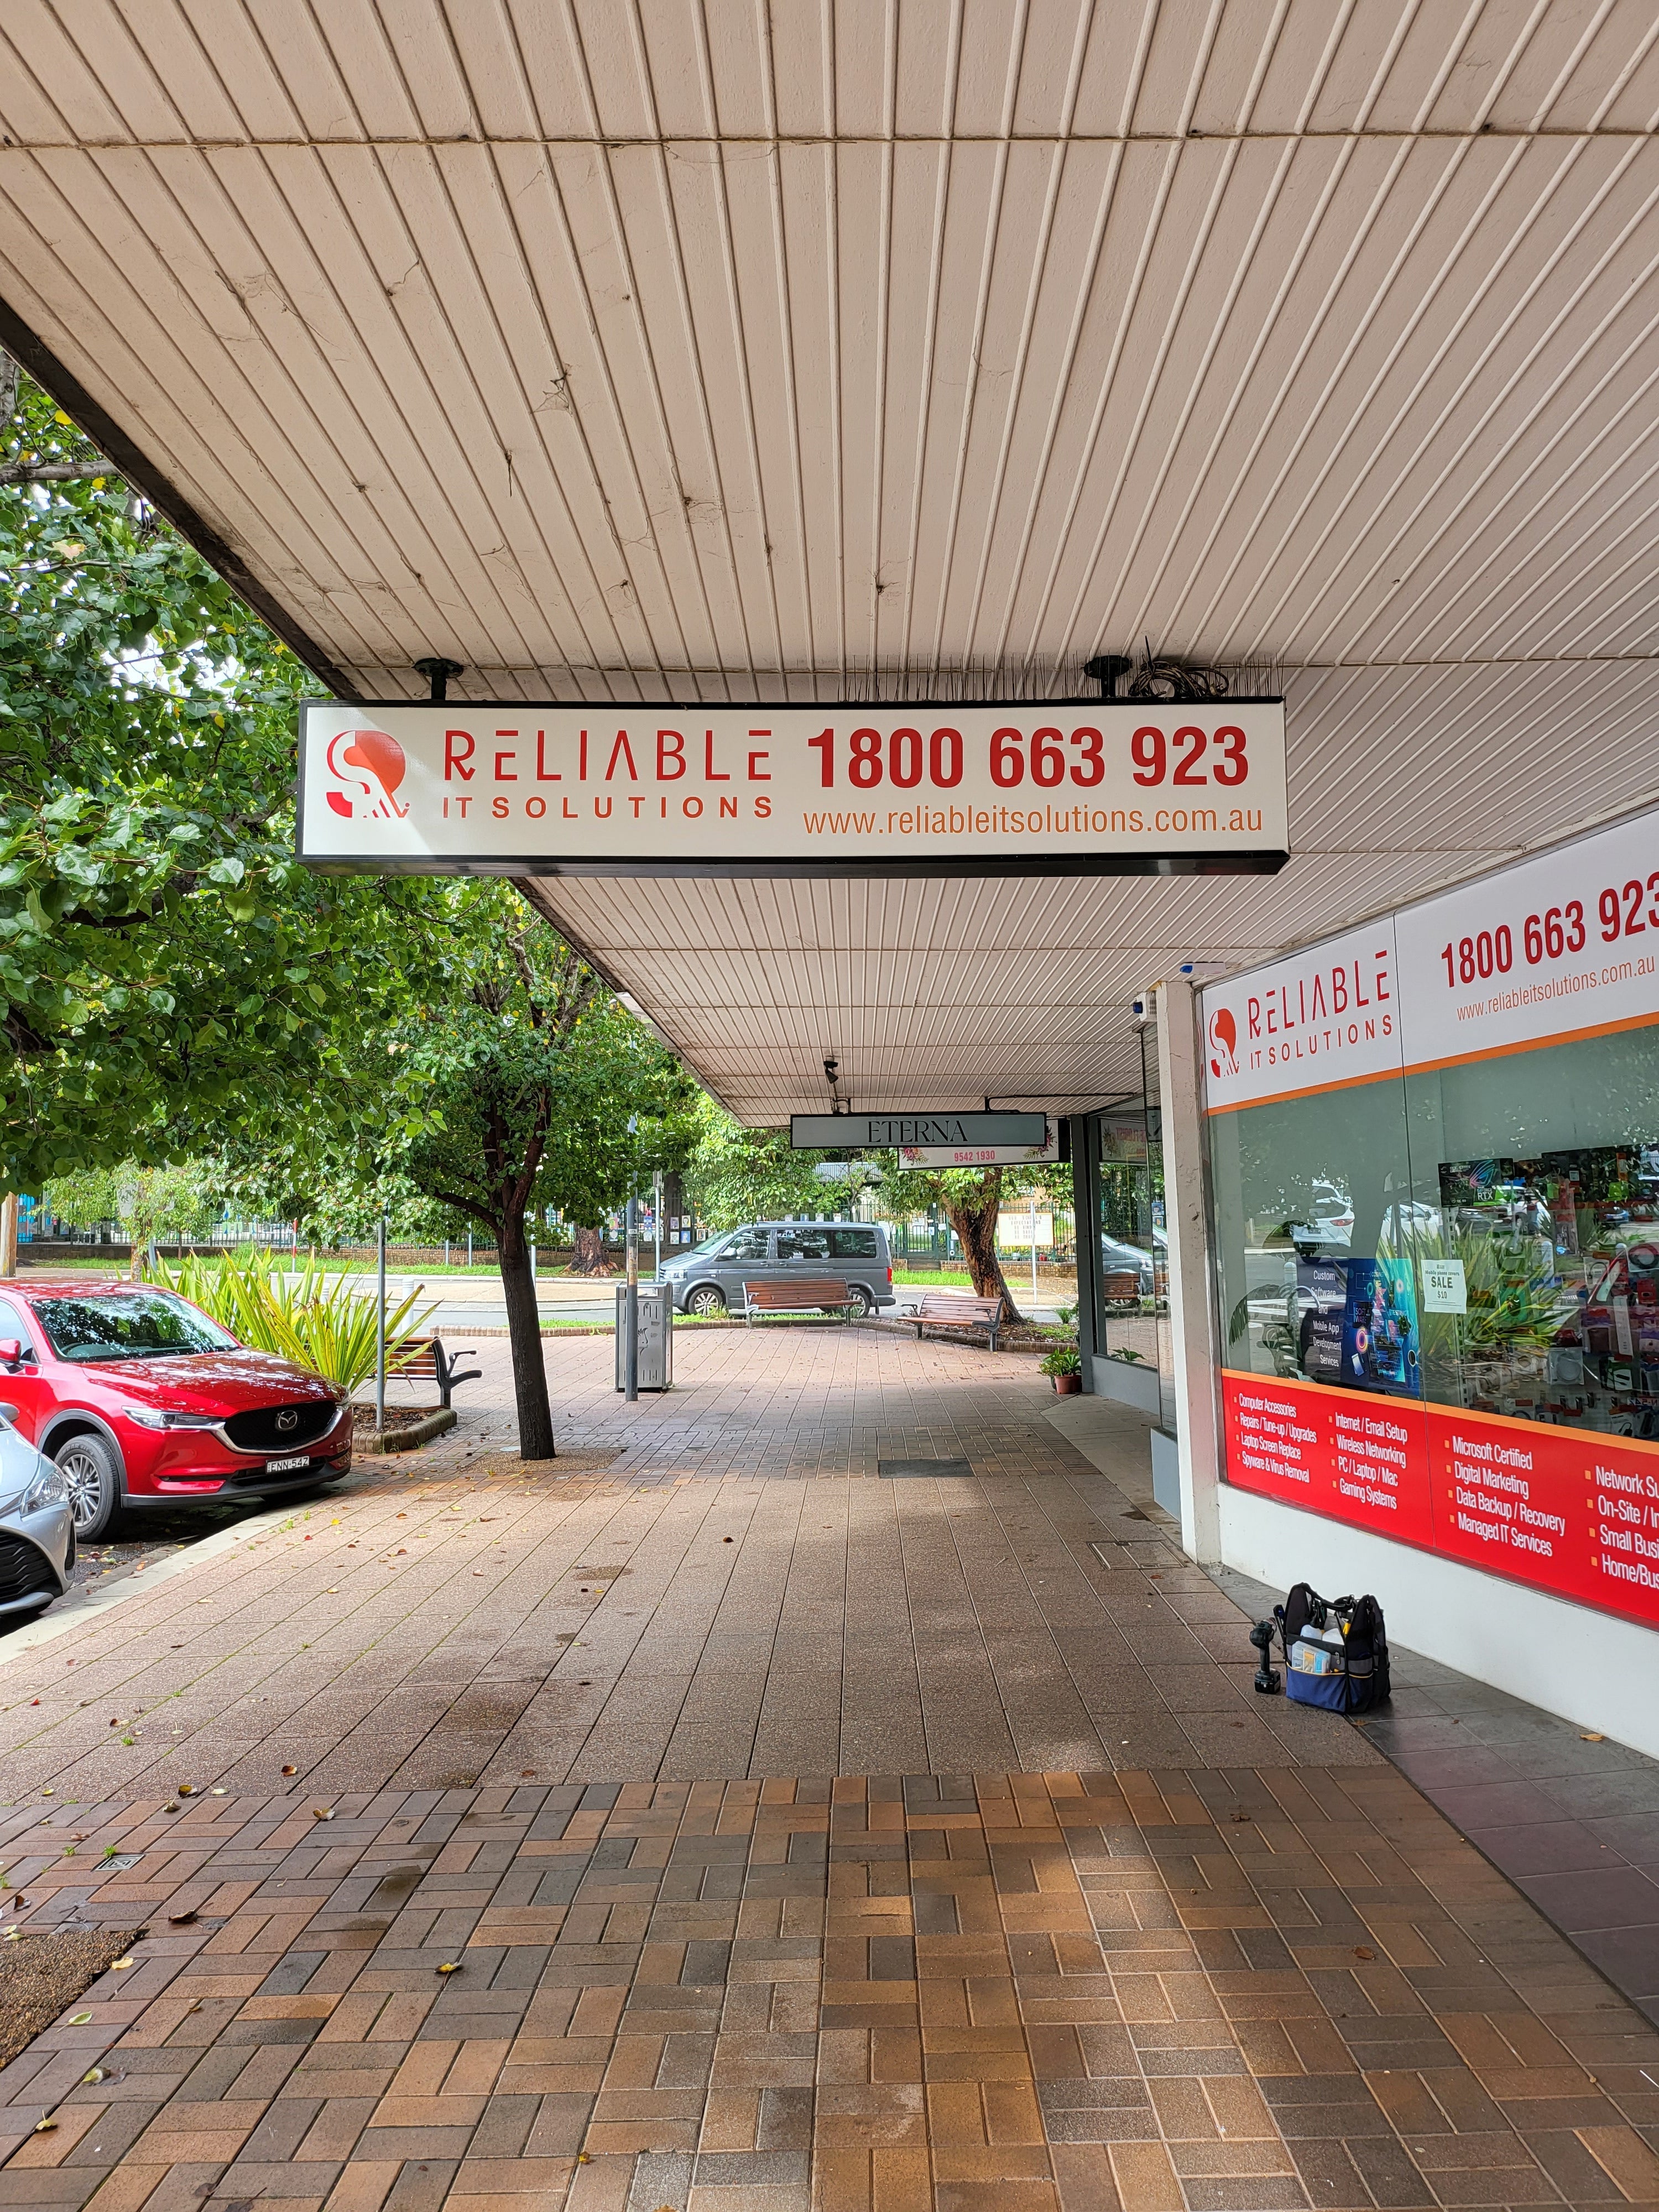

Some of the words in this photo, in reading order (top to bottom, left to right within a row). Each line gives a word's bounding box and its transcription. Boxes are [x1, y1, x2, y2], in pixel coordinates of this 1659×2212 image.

[445, 730, 771, 780] RELIABLE
[808, 728, 963, 789] 1800
[989, 727, 1105, 788] 663
[1131, 726, 1249, 786] 923
[443, 797, 473, 818] IT
[492, 796, 771, 818] SOLUTIONS
[803, 804, 1262, 834] www.reliableitsolutions.com.au
[1441, 925, 1513, 988] 1800
[1524, 900, 1585, 964] 663
[1598, 872, 1659, 942] 923
[1248, 950, 1390, 1040] RELIABLE
[1457, 956, 1655, 1021] www.reliableitsolutions.com.au
[1250, 1051, 1261, 1070] IT
[1269, 1014, 1392, 1065] SOLUTIONS
[868, 1120, 968, 1142] ETERNA
[954, 1151, 973, 1162] 9542
[976, 1150, 995, 1161] 1930
[1477, 1192, 1493, 1200] RTX
[1313, 1270, 1335, 1281] Custom
[1431, 1276, 1453, 1288] SALE
[1311, 1287, 1336, 1298] Software
[1437, 1290, 1447, 1300] $10
[1318, 1306, 1328, 1314] and
[1313, 1319, 1328, 1332] Mobile
[1328, 1322, 1339, 1335] App
[1313, 1337, 1342, 1352] Development
[1320, 1354, 1339, 1367] Services
[1239, 1392, 1264, 1411] Computer
[1264, 1397, 1297, 1418] Accessories
[1240, 1412, 1259, 1430] Repairs
[1260, 1416, 1262, 1430] /
[1262, 1417, 1285, 1438] Tune-up
[1285, 1422, 1288, 1436] /
[1289, 1423, 1317, 1443] Upgrades
[1335, 1412, 1361, 1432] Internet
[1361, 1417, 1364, 1432] /
[1365, 1418, 1385, 1437] Email
[1386, 1422, 1407, 1445] Setup
[1241, 1431, 1259, 1451] Laptop
[1259, 1436, 1278, 1454] Screen
[1279, 1441, 1301, 1460] Replace
[1336, 1433, 1364, 1455] Wireless
[1365, 1440, 1406, 1469] Networking
[1452, 1436, 1493, 1462] Microsoft
[1494, 1444, 1533, 1470] Certified
[1242, 1451, 1265, 1470] Spyware
[1265, 1457, 1270, 1472] &
[1270, 1458, 1284, 1476] Virus
[1285, 1462, 1310, 1483] Removal
[1338, 1455, 1348, 1473] PC
[1349, 1458, 1352, 1474] /
[1353, 1459, 1376, 1484] Laptop
[1377, 1466, 1380, 1481] /
[1382, 1467, 1399, 1486] Mac
[1454, 1461, 1481, 1485] Digital
[1482, 1467, 1529, 1500] Marketing
[1595, 1465, 1645, 1495] Network
[1339, 1478, 1366, 1504] Gaming
[1366, 1485, 1397, 1510] Systems
[1456, 1486, 1477, 1509] Data
[1478, 1491, 1512, 1521] Backup
[1514, 1501, 1518, 1520] /
[1520, 1503, 1566, 1537] Recovery
[1598, 1495, 1641, 1524] On-Site
[1643, 1505, 1648, 1526] /
[1458, 1511, 1499, 1541] Managed
[1500, 1524, 1509, 1543] IT
[1511, 1527, 1553, 1557] Services
[1600, 1524, 1632, 1551] Small
